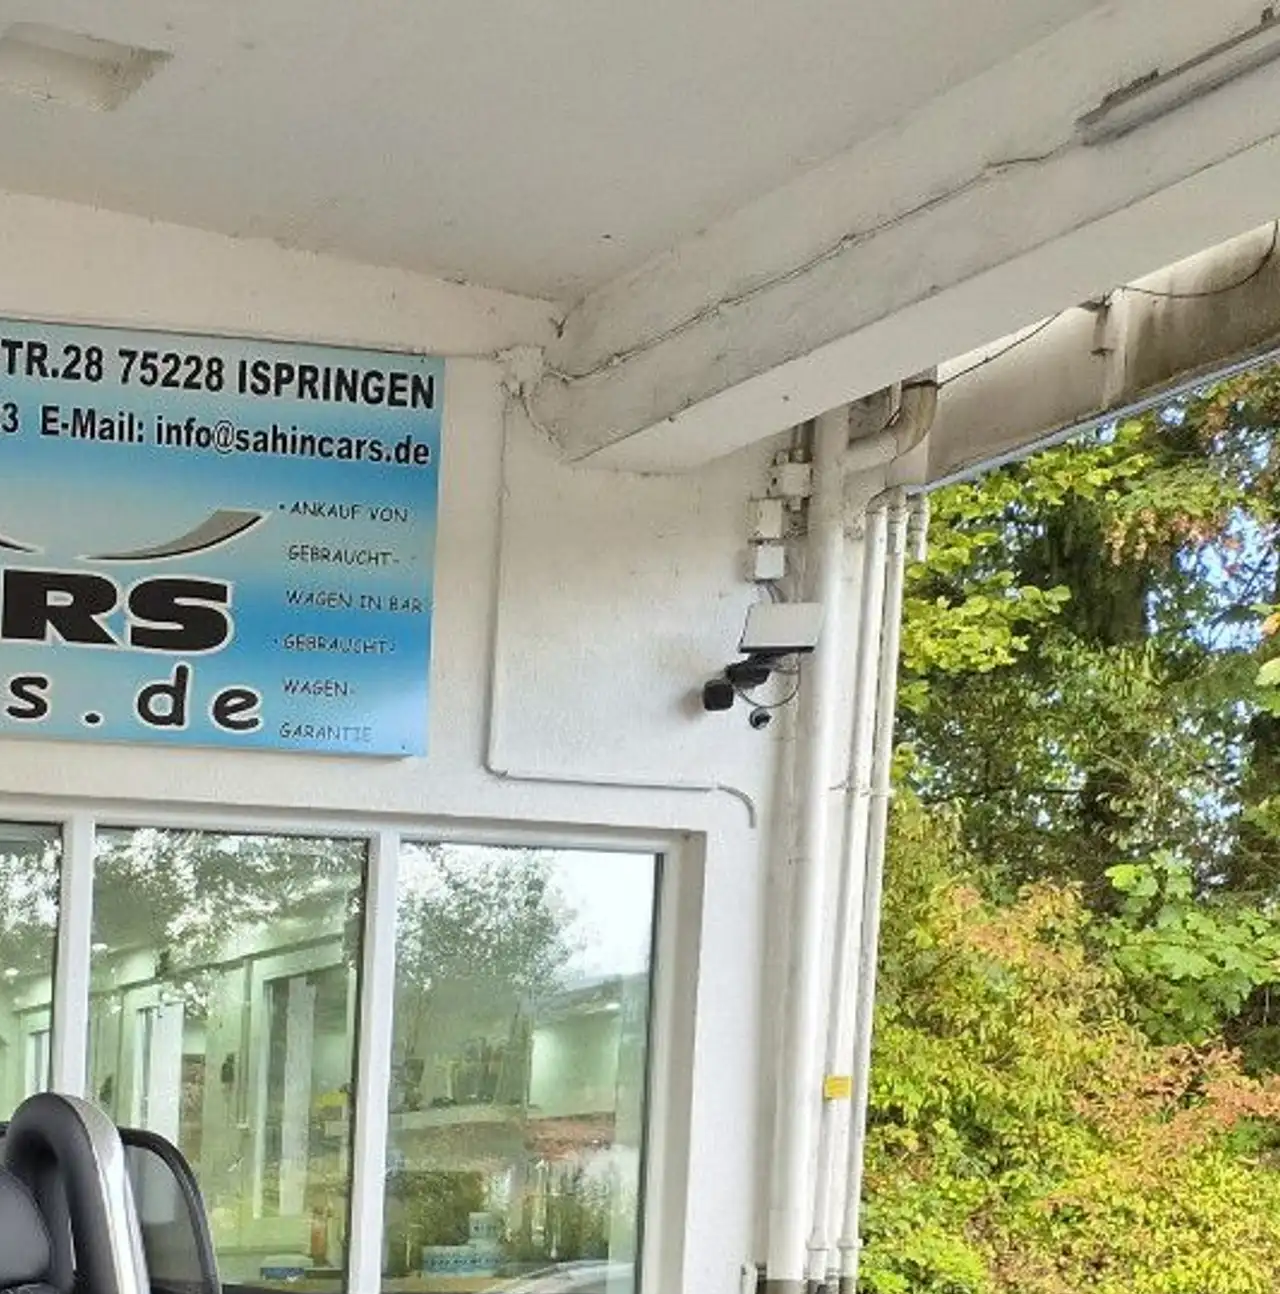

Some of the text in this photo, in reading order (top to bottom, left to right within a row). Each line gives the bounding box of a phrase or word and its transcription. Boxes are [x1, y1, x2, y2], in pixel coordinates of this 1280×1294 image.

[119, 348, 225, 392] 75228
[238, 359, 435, 410] ISPRINGEN
[40, 404, 145, 443] E-Mail:
[155, 415, 431, 465] info@sahincars.de
[290, 501, 408, 523] ANKAUF VON
[289, 545, 400, 565] GEBRAUCHT-
[286, 590, 423, 613] WAGEN IN BAR
[283, 633, 396, 653] GEBRAUCHT-
[279, 721, 374, 742] GARANTIE
